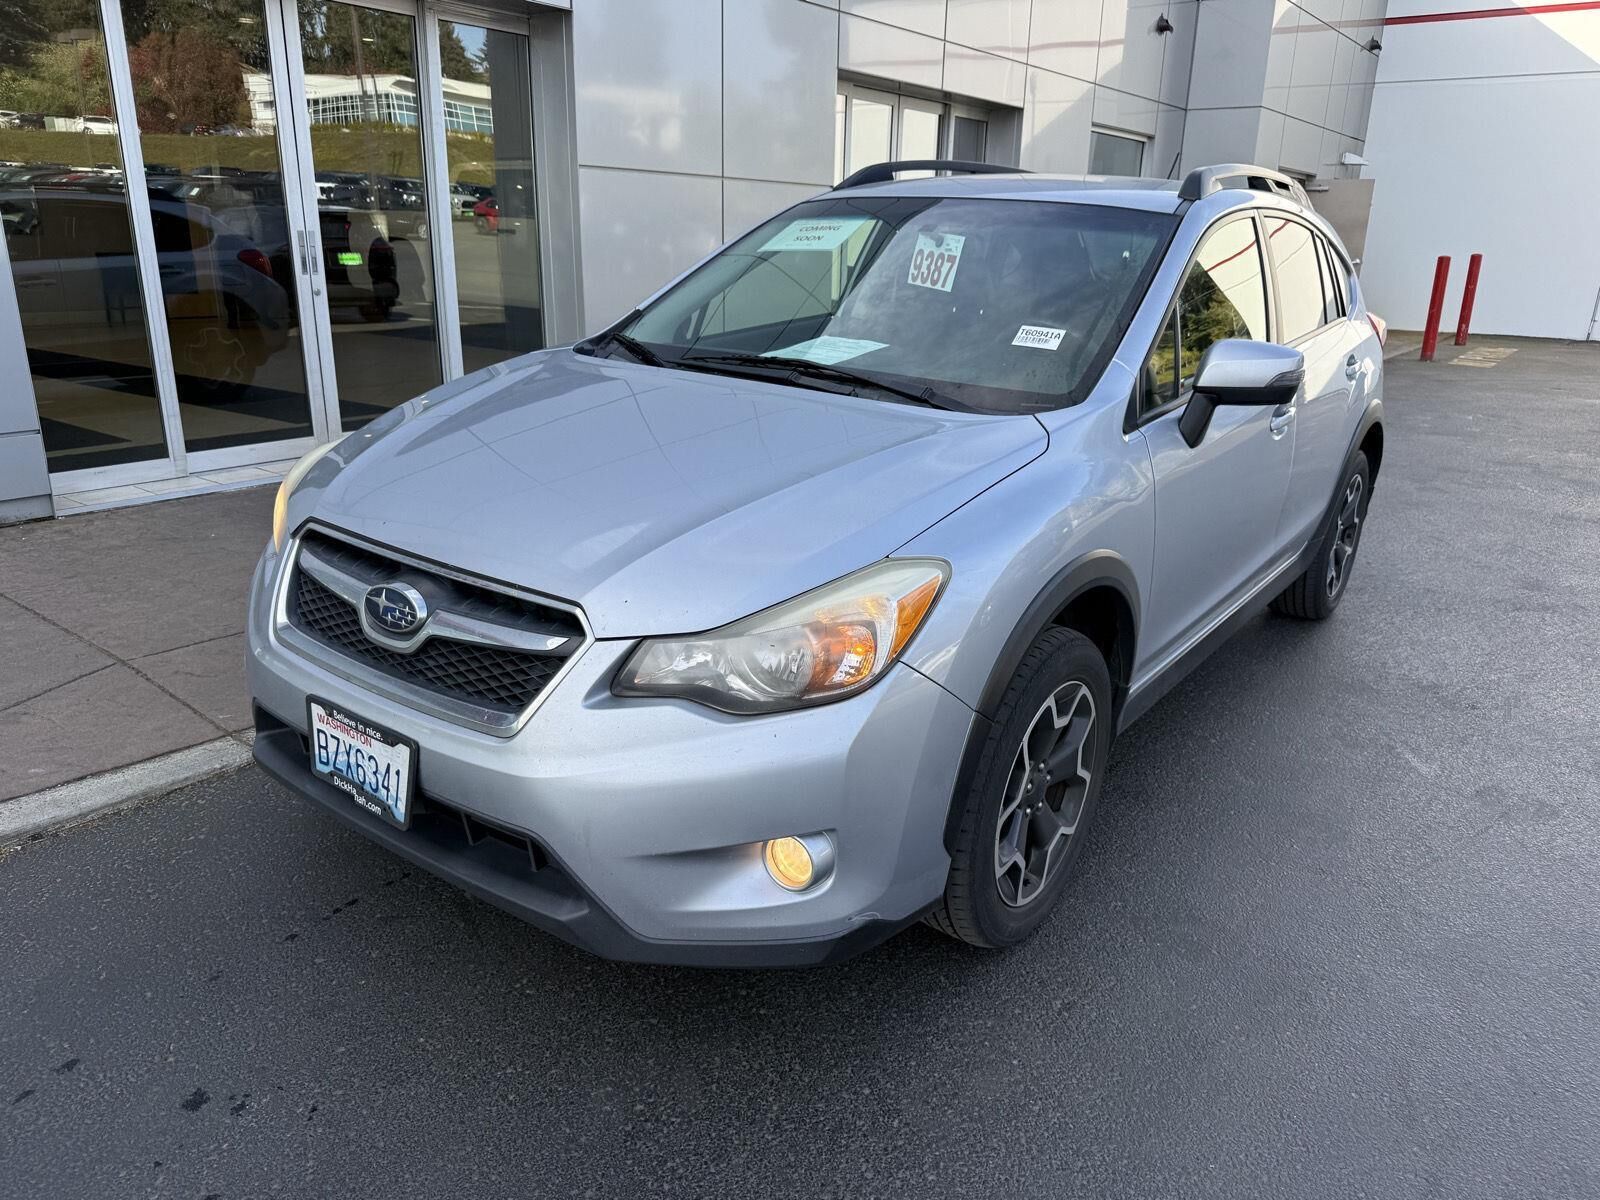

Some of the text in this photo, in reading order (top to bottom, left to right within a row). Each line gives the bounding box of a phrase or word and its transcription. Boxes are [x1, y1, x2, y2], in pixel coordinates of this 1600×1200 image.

[910, 248, 958, 289] 9387
[1020, 328, 1061, 340] T60941A
[316, 712, 372, 748] WASHINGTON
[333, 710, 356, 729] Believe
[357, 721, 365, 733] in
[316, 728, 401, 809] BZX6341
